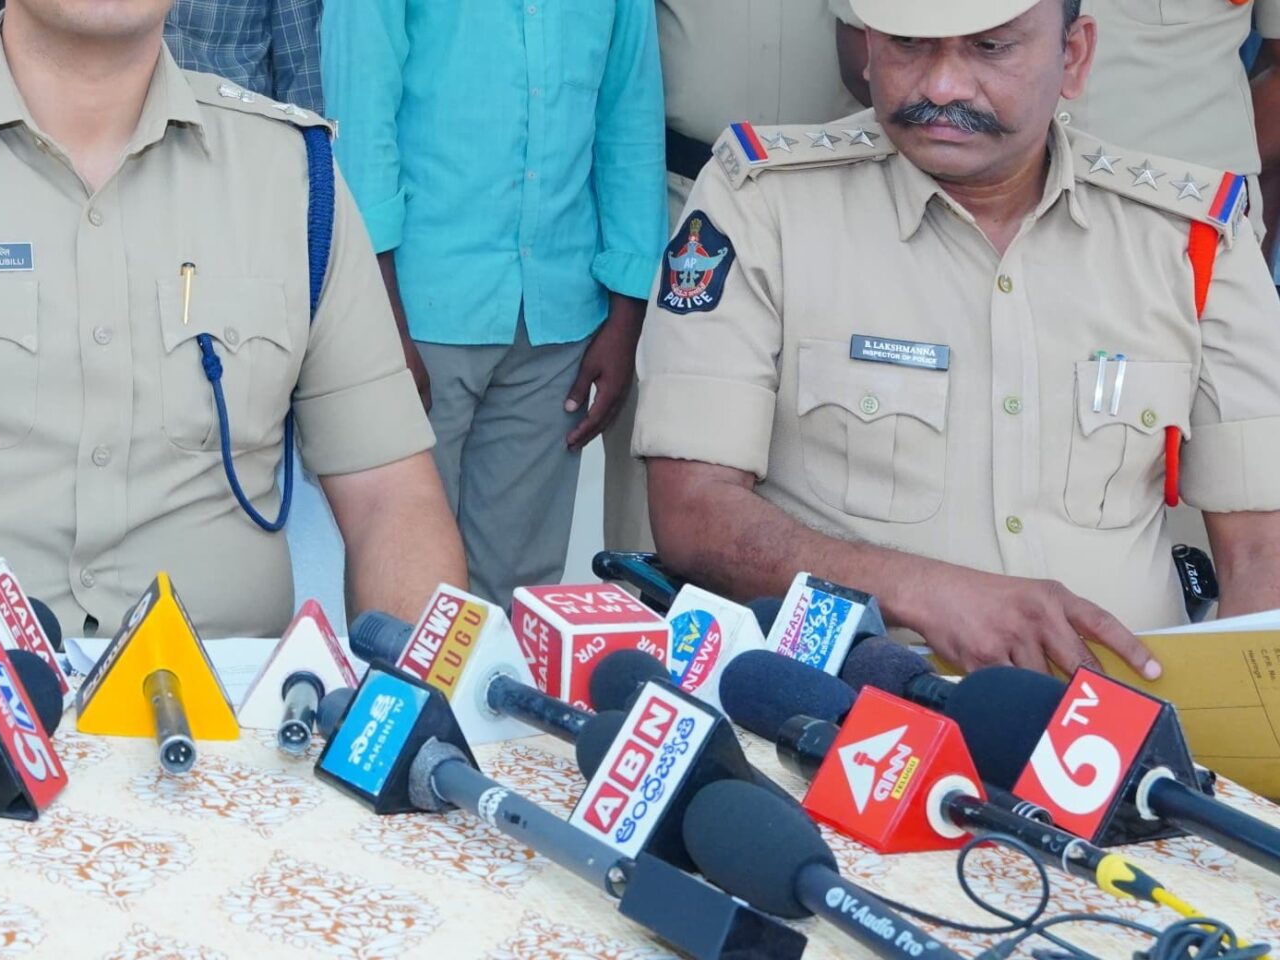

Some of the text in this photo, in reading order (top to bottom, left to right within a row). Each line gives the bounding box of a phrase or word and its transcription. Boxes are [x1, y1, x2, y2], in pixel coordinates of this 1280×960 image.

[683, 258, 697, 269] AP
[663, 291, 713, 309] POLICE
[862, 349, 900, 360] INSPECTOR
[912, 355, 937, 365] POLICE
[873, 341, 936, 357] LAKSHMANNA
[543, 591, 633, 606] CVR
[559, 603, 644, 615] NEWS
[777, 593, 809, 656] ERFASTT
[408, 596, 460, 670] NEWS
[435, 609, 482, 687] LUGU
[522, 613, 539, 665] VR
[538, 623, 550, 693] EALTH
[574, 635, 606, 664] CVR
[681, 631, 720, 691] NEWS
[1060, 681, 1100, 728] TV
[363, 697, 405, 772] SAKSHI TV
[591, 702, 674, 830] ABN
[615, 716, 696, 844] ఆంధ్రజ్యోతి
[894, 759, 917, 795] TELUGU
[841, 894, 924, 957] V-Audio Pro
